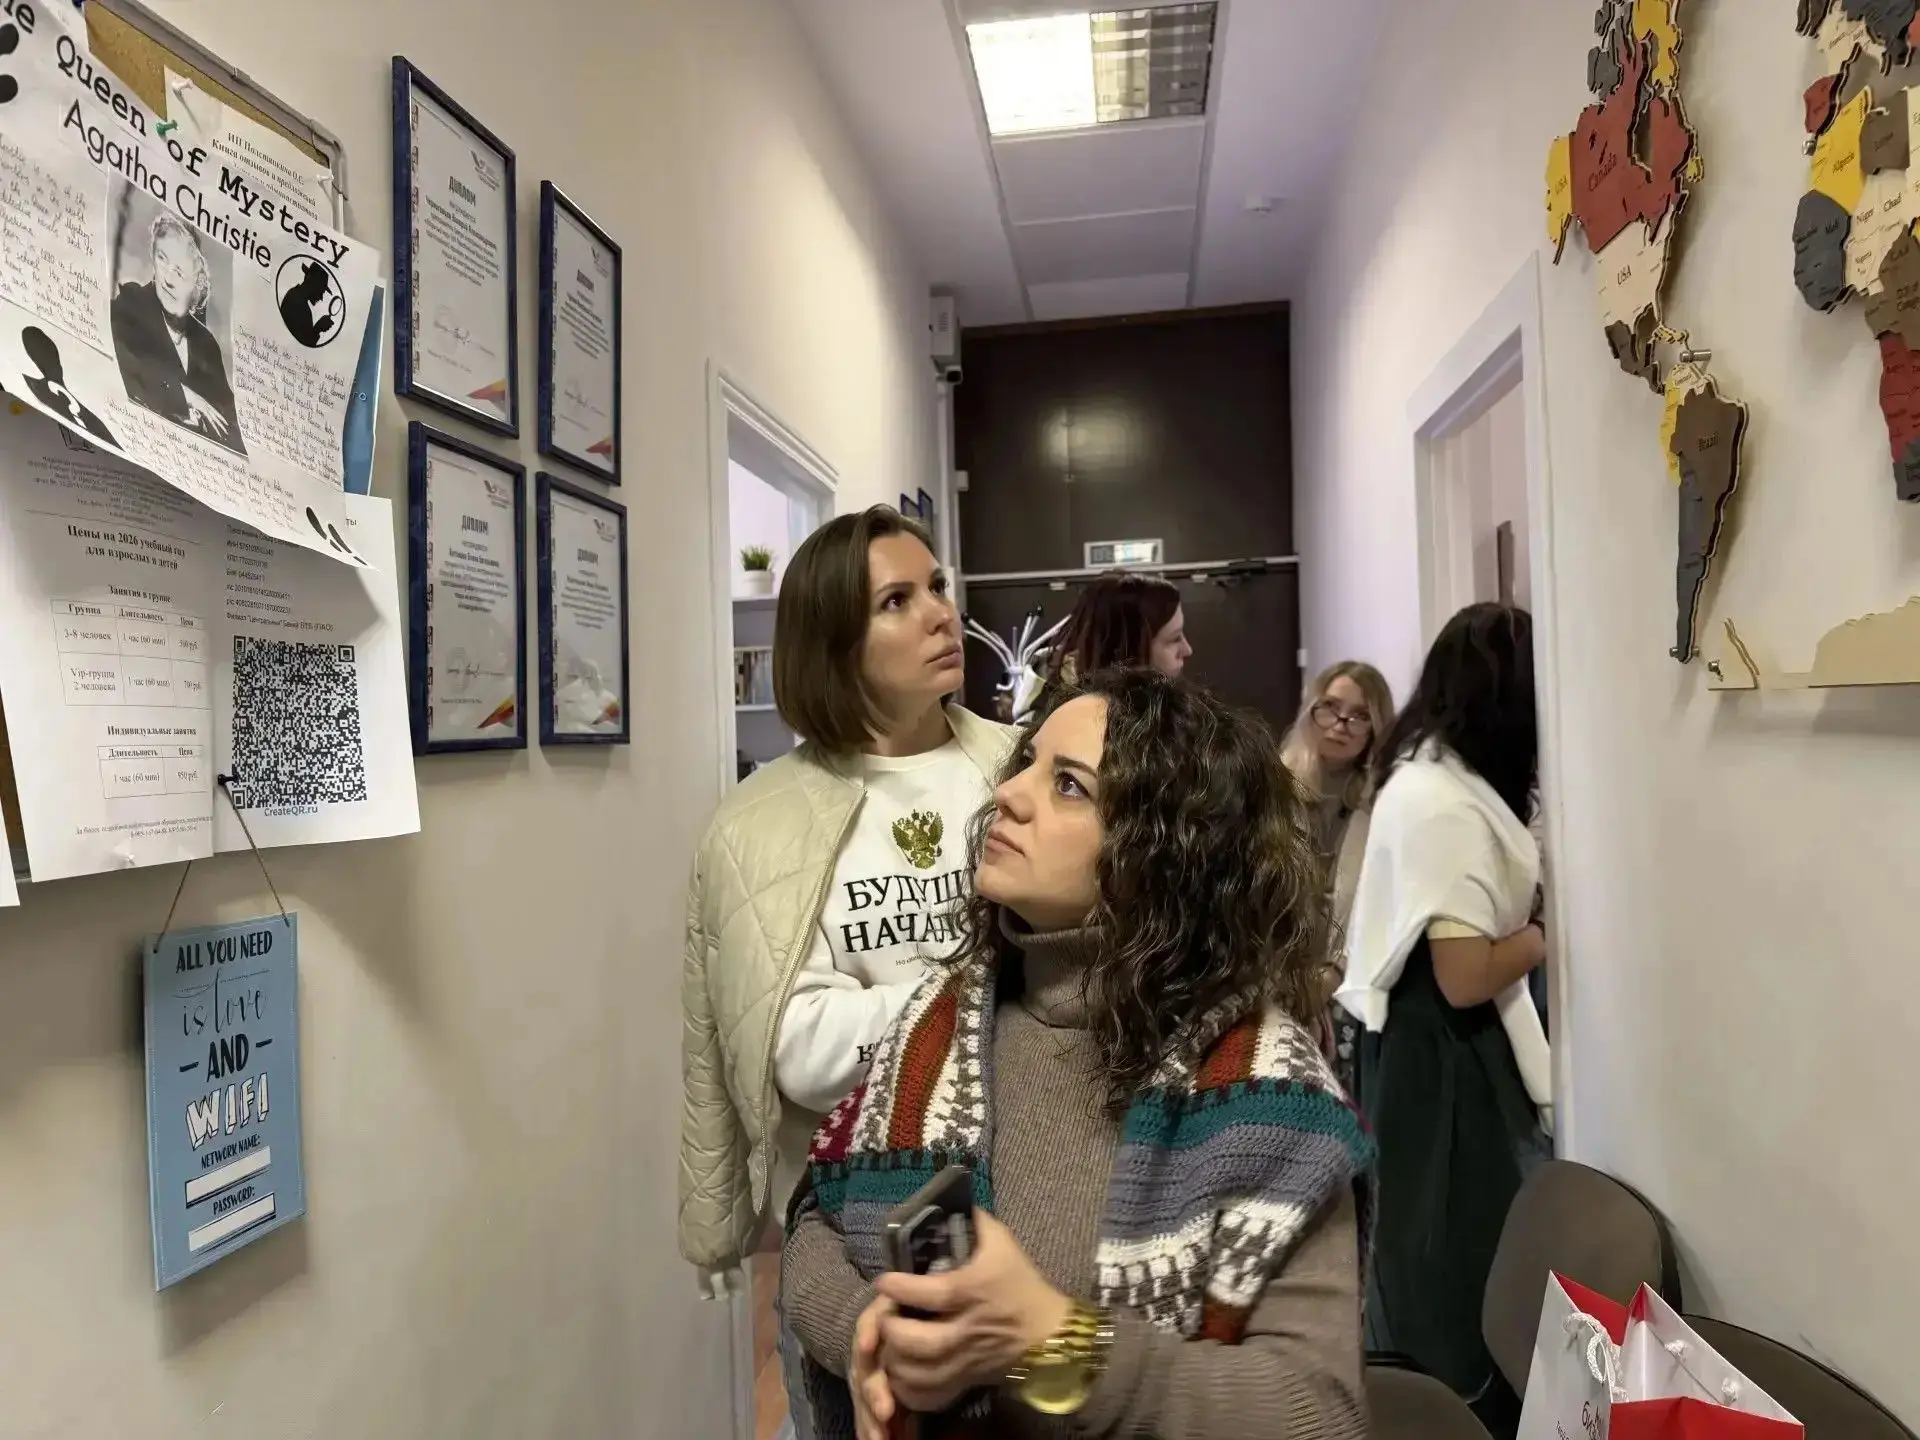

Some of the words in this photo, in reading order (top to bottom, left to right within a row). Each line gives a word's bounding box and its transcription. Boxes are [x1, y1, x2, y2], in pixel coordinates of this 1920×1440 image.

[56, 35, 147, 137] Queen
[167, 139, 208, 177] of
[218, 166, 350, 269] Mystery
[211, 138, 239, 159] Книга
[1588, 152, 1618, 192] Canada
[1832, 150, 1855, 174] Algeria
[64, 98, 168, 202] Agatha
[175, 184, 272, 268] Christie
[1883, 191, 1902, 213] Chad
[1856, 208, 1874, 224] Niger
[1616, 264, 1632, 285] USA
[461, 514, 489, 535] ДИПЛОМ
[67, 524, 101, 541] Цены
[104, 532, 116, 541] на
[118, 531, 140, 546] 2026
[140, 538, 173, 555] учебный
[86, 546, 106, 557] для
[108, 549, 151, 564] взрослых
[159, 558, 179, 570] детей
[108, 584, 142, 599] Занятия
[148, 592, 172, 604] группе
[68, 603, 102, 616] Группа
[118, 608, 165, 622] Длительность
[64, 628, 78, 640] 3-8
[79, 630, 112, 641] человек
[74, 682, 79, 691] 2
[80, 682, 117, 691] человека
[107, 725, 172, 737] Индивидуальные
[108, 748, 158, 759] Длительность
[178, 747, 193, 756] Цена
[263, 805, 319, 817] CreateQR.ru
[843, 869, 972, 912] БУДУЩ
[840, 912, 964, 953] НАЧАЛ
[176, 943, 204, 974] ALL
[206, 936, 237, 966] YOU
[240, 930, 273, 960] NEED
[183, 1005, 208, 1036] is
[215, 967, 265, 1034] love
[207, 1033, 250, 1082] AND
[185, 1071, 270, 1151] WIFI
[201, 1142, 238, 1170] NETWORK
[238, 1131, 261, 1154] NAME:
[213, 1184, 256, 1216] PASSWORD:
